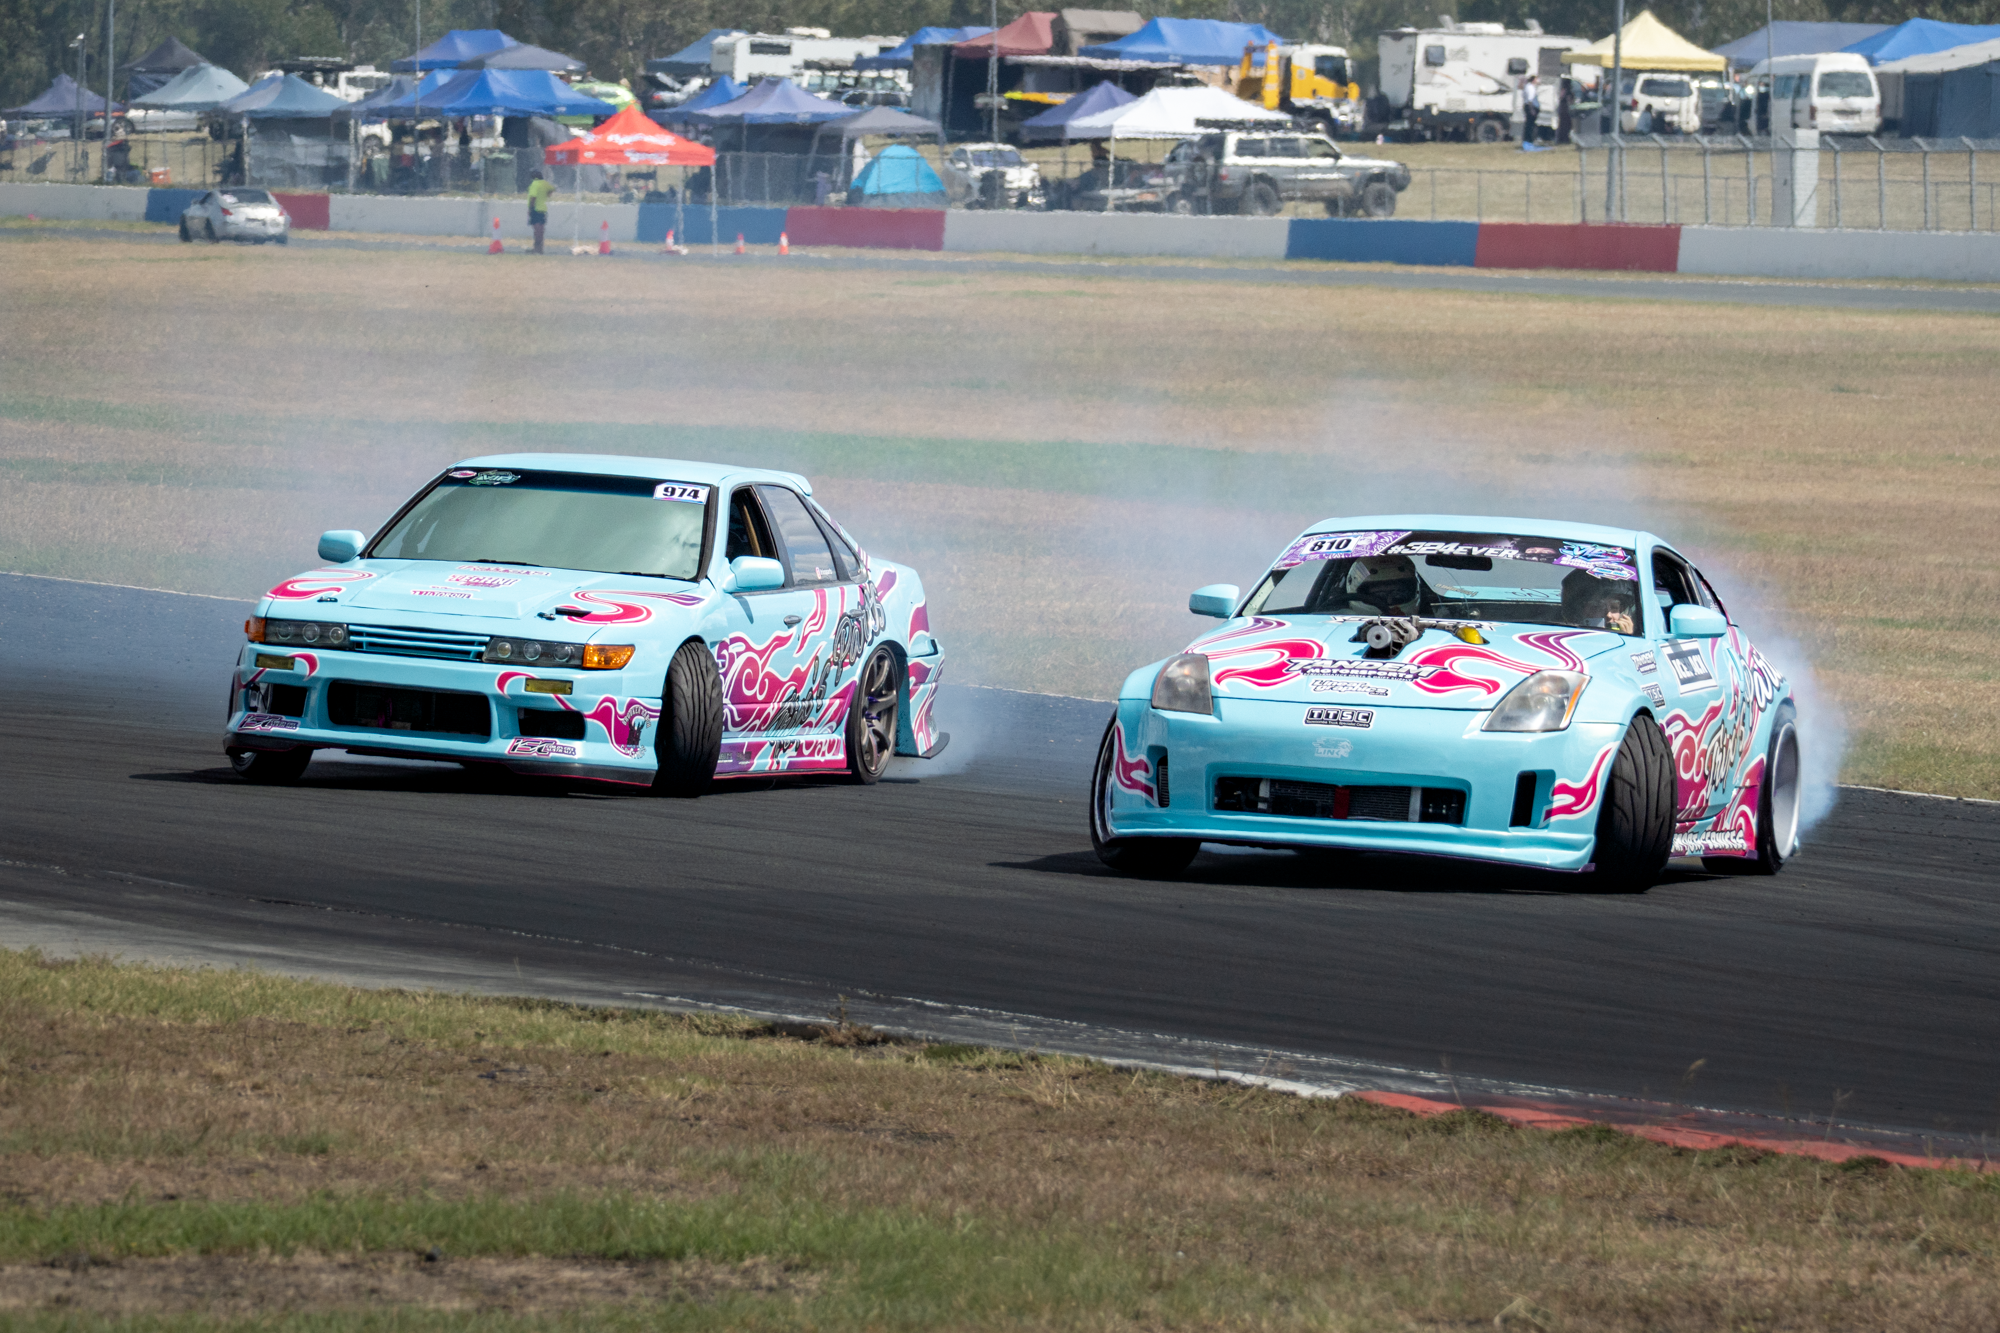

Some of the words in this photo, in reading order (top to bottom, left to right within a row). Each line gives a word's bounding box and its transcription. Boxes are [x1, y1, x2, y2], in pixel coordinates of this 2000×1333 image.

[662, 486, 700, 499] 974
[1309, 539, 1352, 551] 810
[1387, 542, 1519, 559] #324EVER
[1285, 659, 1446, 678] TANDEM
[1307, 668, 1414, 679] MOTORSPORTS
[1311, 710, 1370, 722] TTSC
